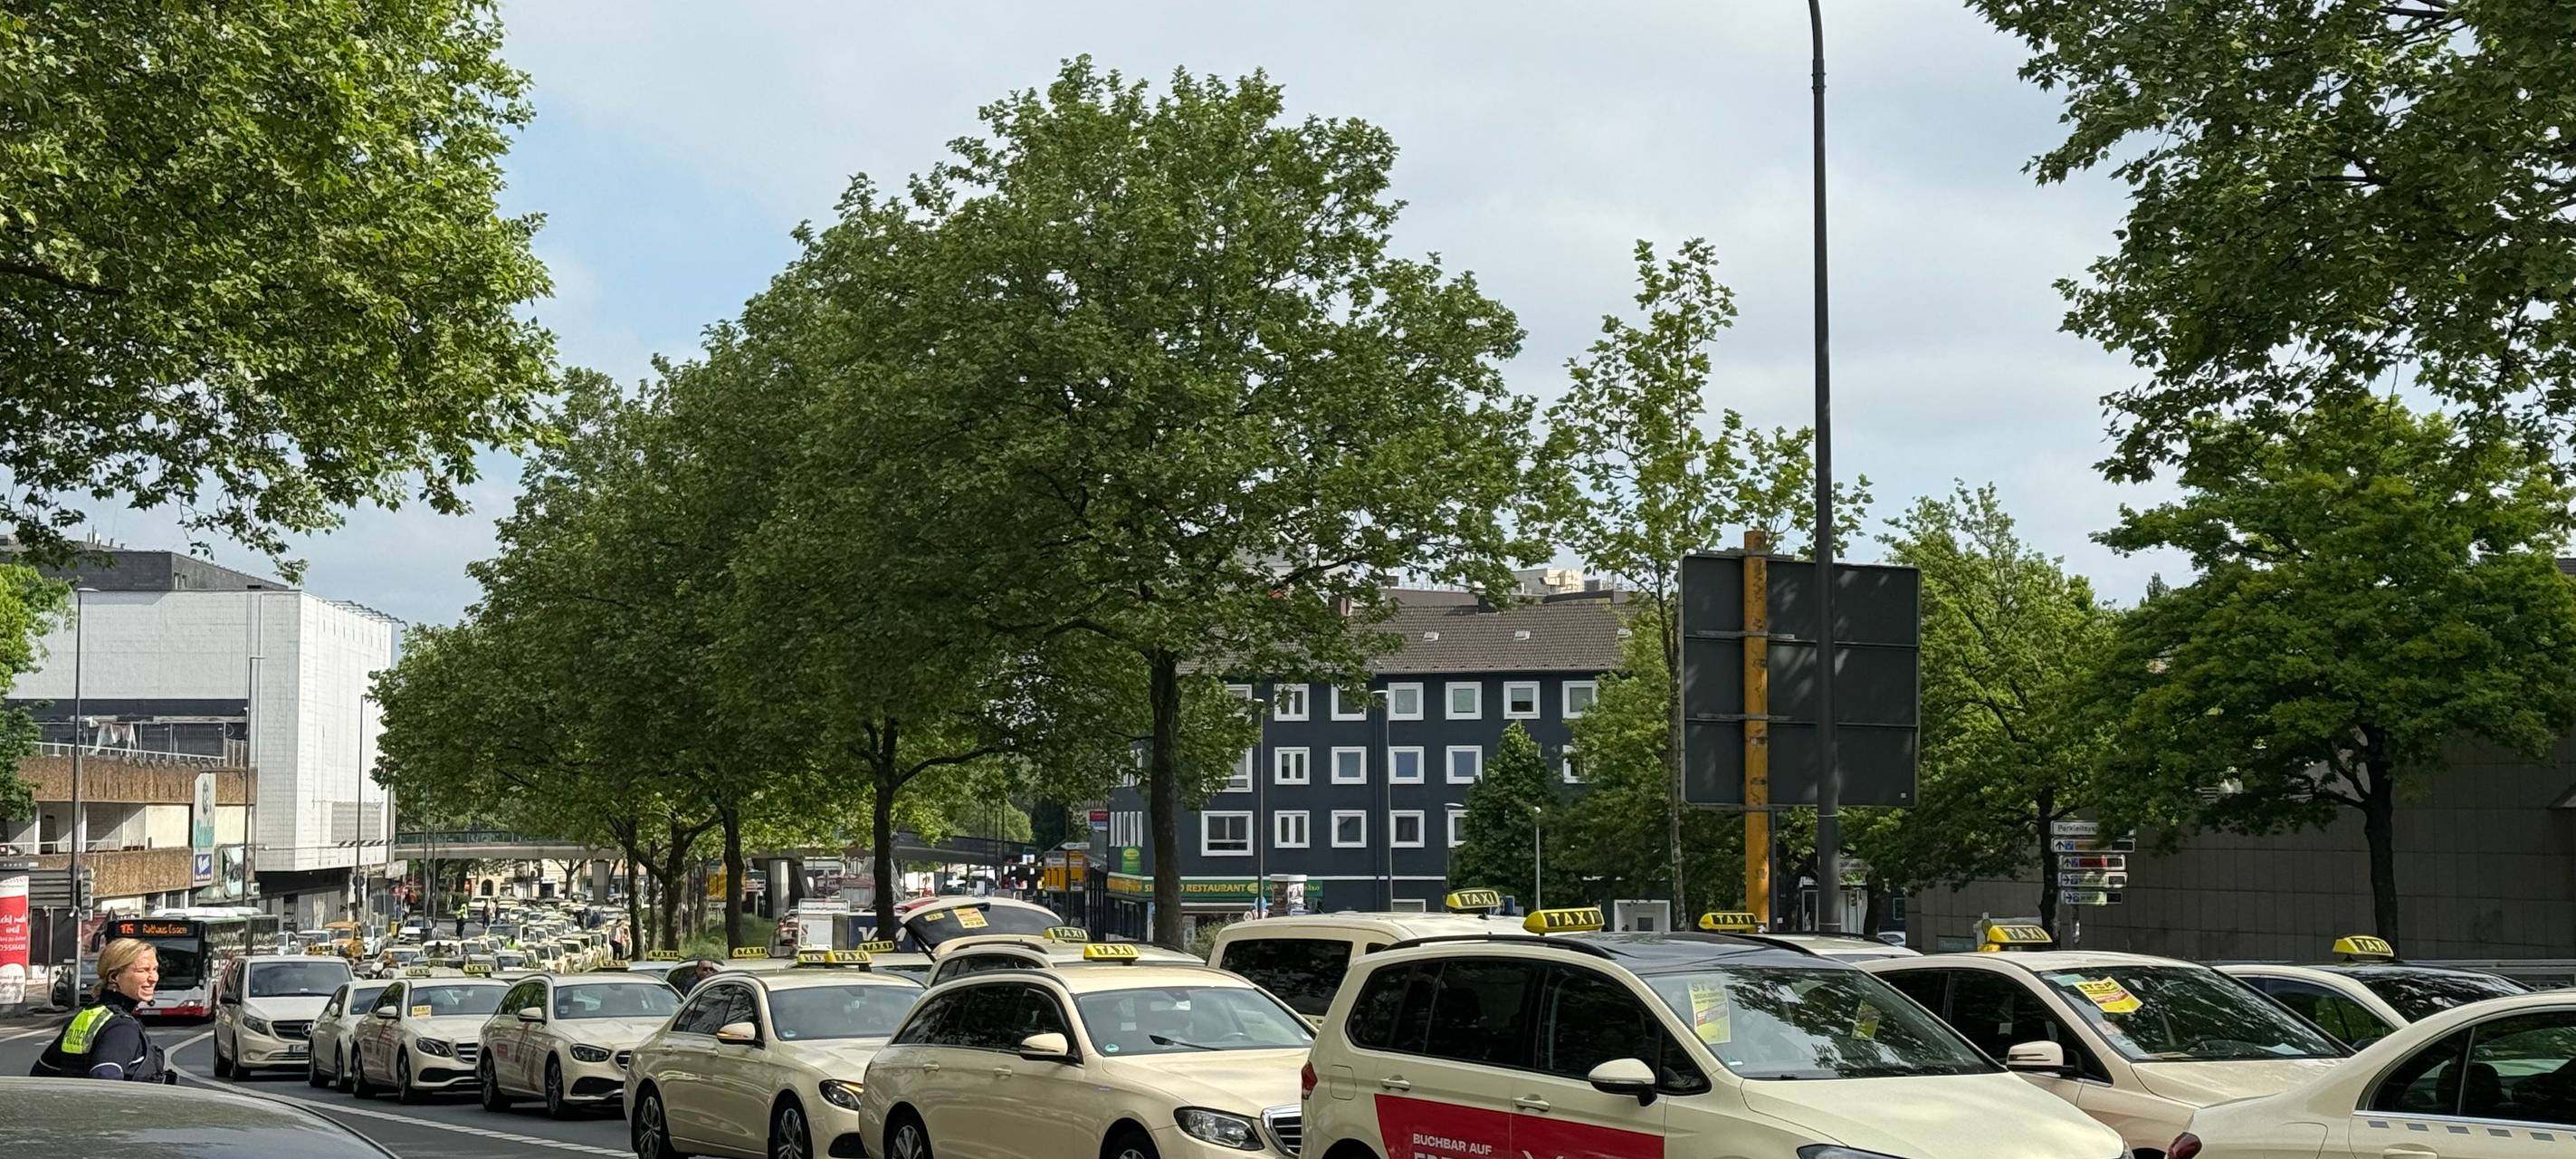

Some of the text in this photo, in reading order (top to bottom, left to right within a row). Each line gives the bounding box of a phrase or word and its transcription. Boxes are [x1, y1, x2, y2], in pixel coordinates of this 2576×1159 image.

[1186, 884, 1245, 893] RESTAURANT
[1462, 893, 1493, 905] TAXI
[1550, 912, 1596, 925] TAXI
[1716, 915, 1751, 924] TAXI
[142, 924, 167, 934] Rathaus
[1056, 929, 1083, 938] TAXI
[2004, 927, 2046, 940] TAXI
[865, 942, 891, 950] TAXI
[1096, 945, 1133, 955] TAXI
[2354, 939, 2389, 952] TAXI
[837, 953, 866, 961] TAXI
[1413, 1133, 1493, 1154] BUCHBAR AUF
